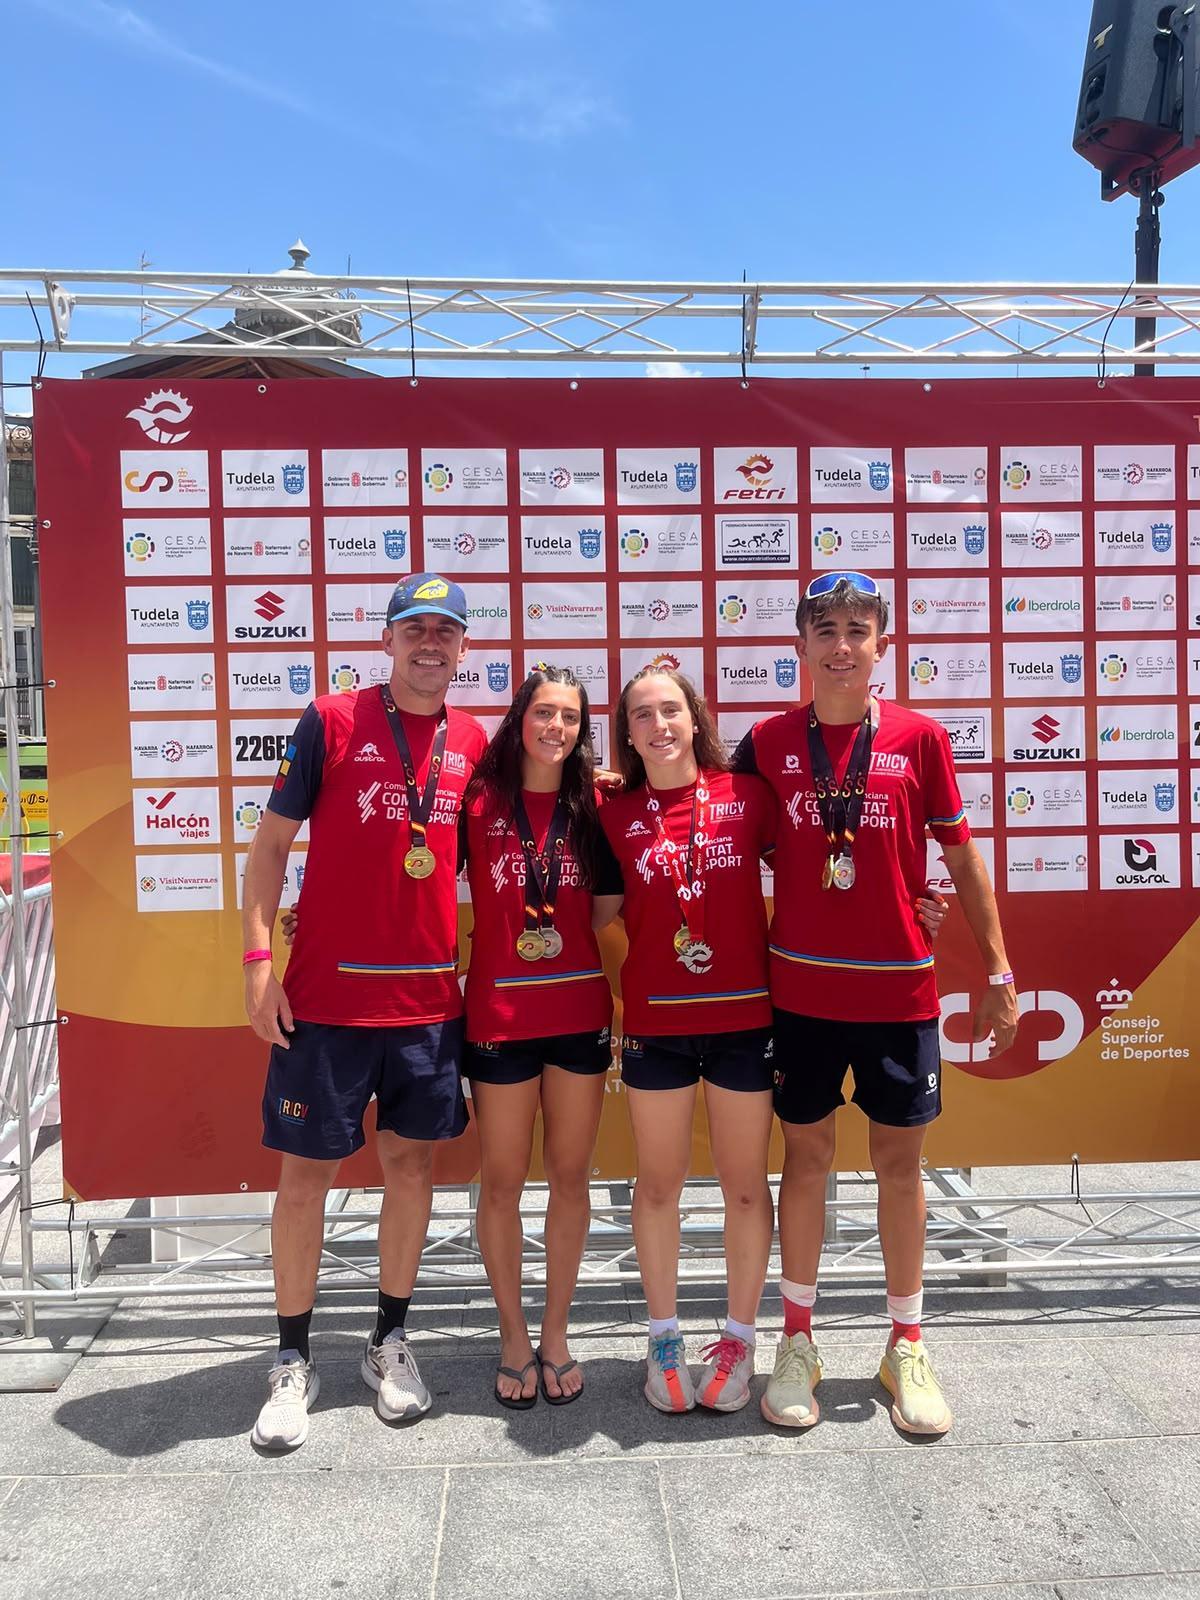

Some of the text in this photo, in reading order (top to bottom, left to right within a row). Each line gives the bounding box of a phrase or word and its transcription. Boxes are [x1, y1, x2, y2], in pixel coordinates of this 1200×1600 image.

[462, 467, 504, 477] CESA
[815, 469, 861, 481] Tudela
[1039, 464, 1079, 474] CESA
[226, 472, 275, 485] Tudela
[621, 470, 668, 482] Tudela
[164, 535, 207, 546] CESA
[658, 532, 699, 542] CESA
[851, 530, 891, 540] CESA
[911, 533, 956, 545] Tudela
[1099, 531, 1144, 543] Tudela
[328, 538, 376, 550] Tudela
[525, 537, 572, 549] Tudela
[546, 605, 603, 613] VisitNavarra.es
[756, 598, 796, 608] CESA
[929, 600, 986, 608] VisitNavarra.es
[1028, 600, 1080, 612] Iberdrola
[131, 609, 179, 621] Tudela
[466, 606, 508, 618] erdrola
[235, 626, 306, 638] SUZUKI
[947, 660, 987, 669] CESA
[1135, 657, 1175, 666] CESA
[369, 667, 388, 677] CE
[721, 666, 768, 679] Tudela
[1009, 662, 1054, 674] Tudela
[233, 673, 281, 685] Tudela
[1123, 729, 1175, 741] Iberdrola
[1013, 748, 1080, 760] SUZUKI
[870, 752, 909, 771] TRICV
[1043, 789, 1082, 799] CESA
[1102, 791, 1147, 803] Tudela
[386, 807, 405, 820] DE
[709, 801, 746, 820] TRICV
[146, 814, 210, 829] Halcón
[180, 828, 210, 839] viajes
[159, 877, 218, 885] VisitNavarra.es
[1115, 873, 1170, 884] austral
[1101, 1016, 1160, 1034] Consejo
[1101, 1032, 1164, 1049] Superior
[1101, 1047, 1190, 1064] de Deportes
